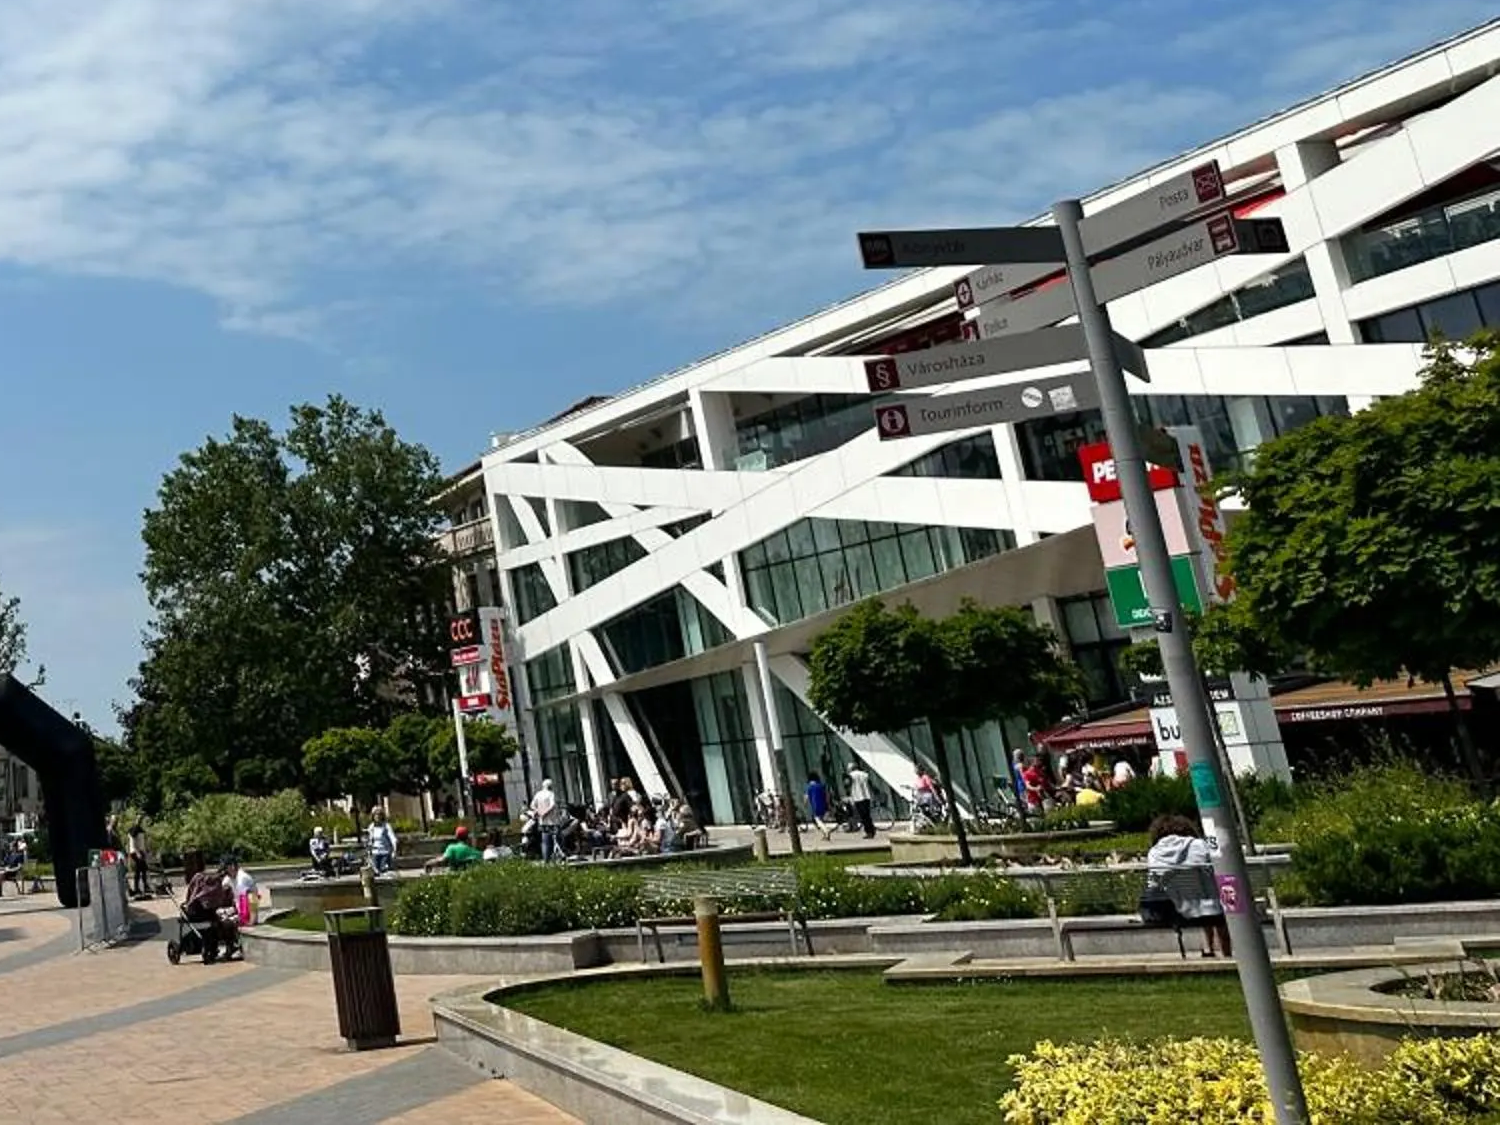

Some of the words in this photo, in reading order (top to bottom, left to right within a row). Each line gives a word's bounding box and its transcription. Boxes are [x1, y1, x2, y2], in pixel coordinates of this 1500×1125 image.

[906, 354, 986, 376] Városháza
[920, 399, 1004, 422] Tourinform
[451, 618, 473, 641] CCC
